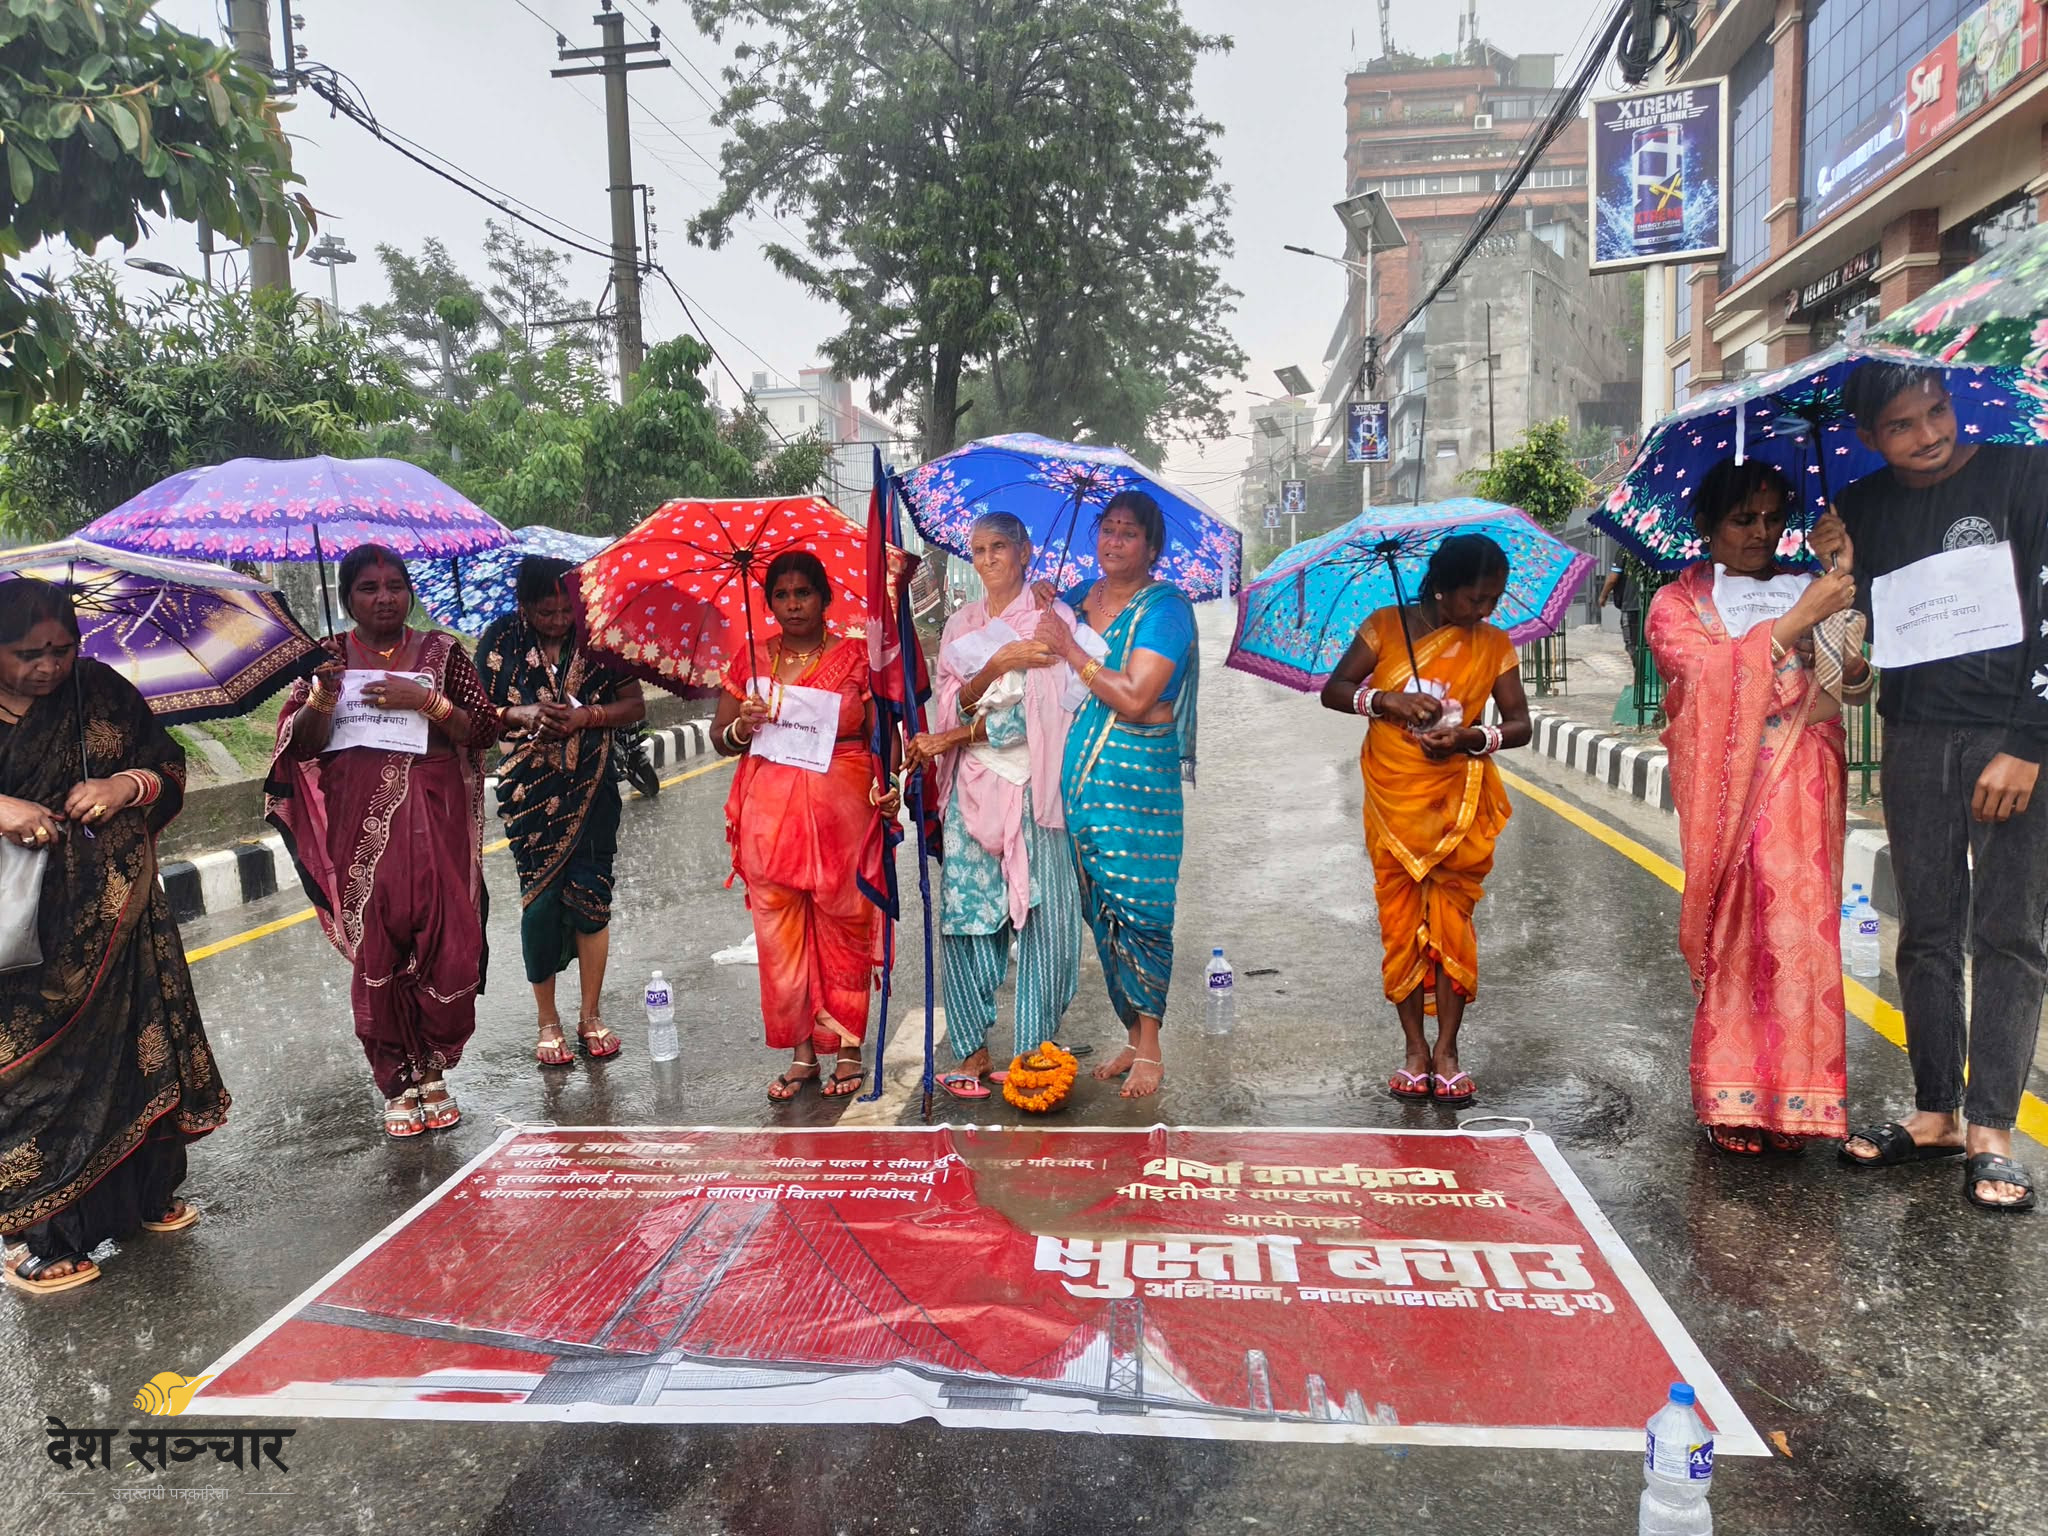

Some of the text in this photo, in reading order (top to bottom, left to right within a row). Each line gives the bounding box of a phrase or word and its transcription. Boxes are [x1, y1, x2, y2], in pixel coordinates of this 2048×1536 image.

[1617, 90, 1693, 119] XTREME
[1625, 110, 1688, 128] ENERGY DRINK
[1355, 403, 1381, 411] XTREME
[782, 720, 793, 729] We
[794, 722, 809, 733] Own
[513, 1156, 575, 1169] भारतीय
[829, 1159, 869, 1169] पहल
[873, 1160, 884, 1169] र
[888, 1158, 931, 1169] सीमा
[1027, 1157, 1095, 1169] गरियोस्
[496, 1170, 614, 1185] सुस्तावासीलाई
[613, 1173, 675, 1184] तत्काल
[822, 1173, 868, 1182] प्रदान
[871, 1171, 936, 1185] गरियोस्
[1250, 1162, 1460, 1189] कार्यक्रम
[479, 1187, 557, 1199] भोगचलन
[558, 1187, 634, 1200] गरिरहेको
[706, 1184, 785, 1202] लालपुर्जा
[784, 1184, 847, 1200] वितरण
[849, 1187, 918, 1201] गरियोस्
[1031, 1231, 1596, 1299] सुस्ता बचाउ
[1297, 1287, 1479, 1308] नवलपरासी
